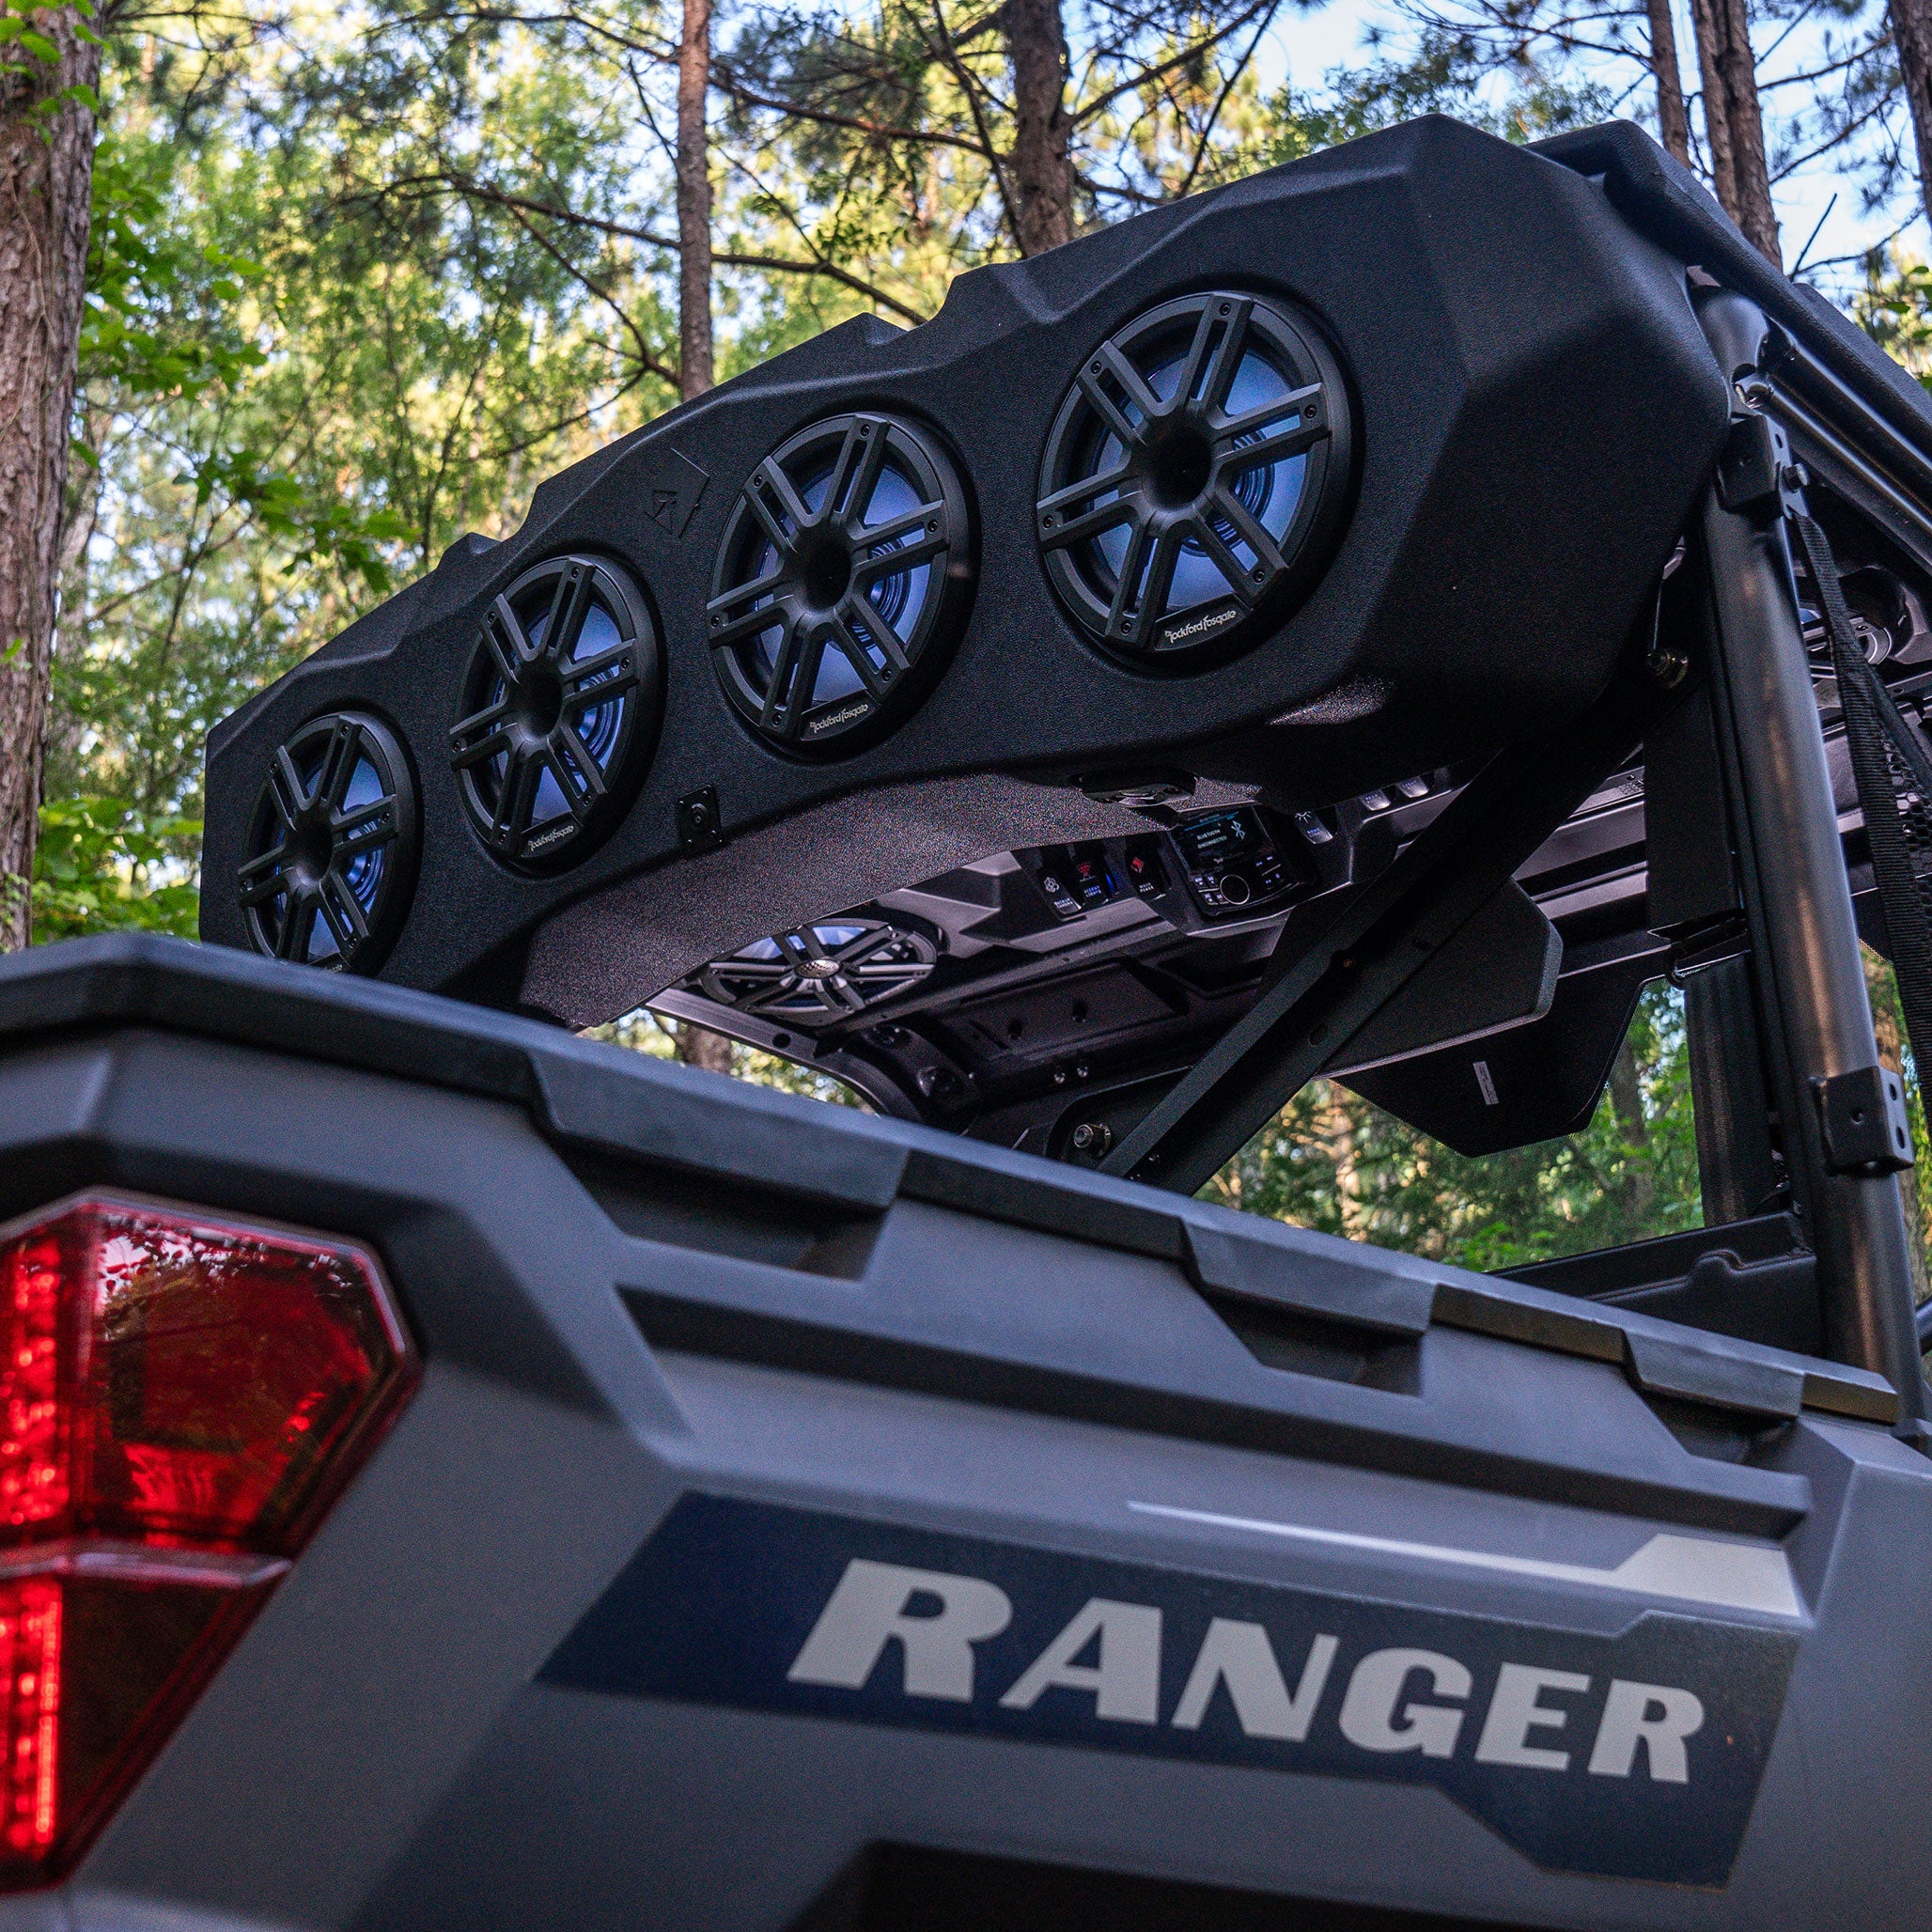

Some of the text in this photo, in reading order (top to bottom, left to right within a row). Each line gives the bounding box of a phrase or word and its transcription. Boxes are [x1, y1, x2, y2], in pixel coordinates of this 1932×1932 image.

[1164, 609, 1237, 644] Rockford Fosgate
[786, 1558, 1705, 1784] RANGER
